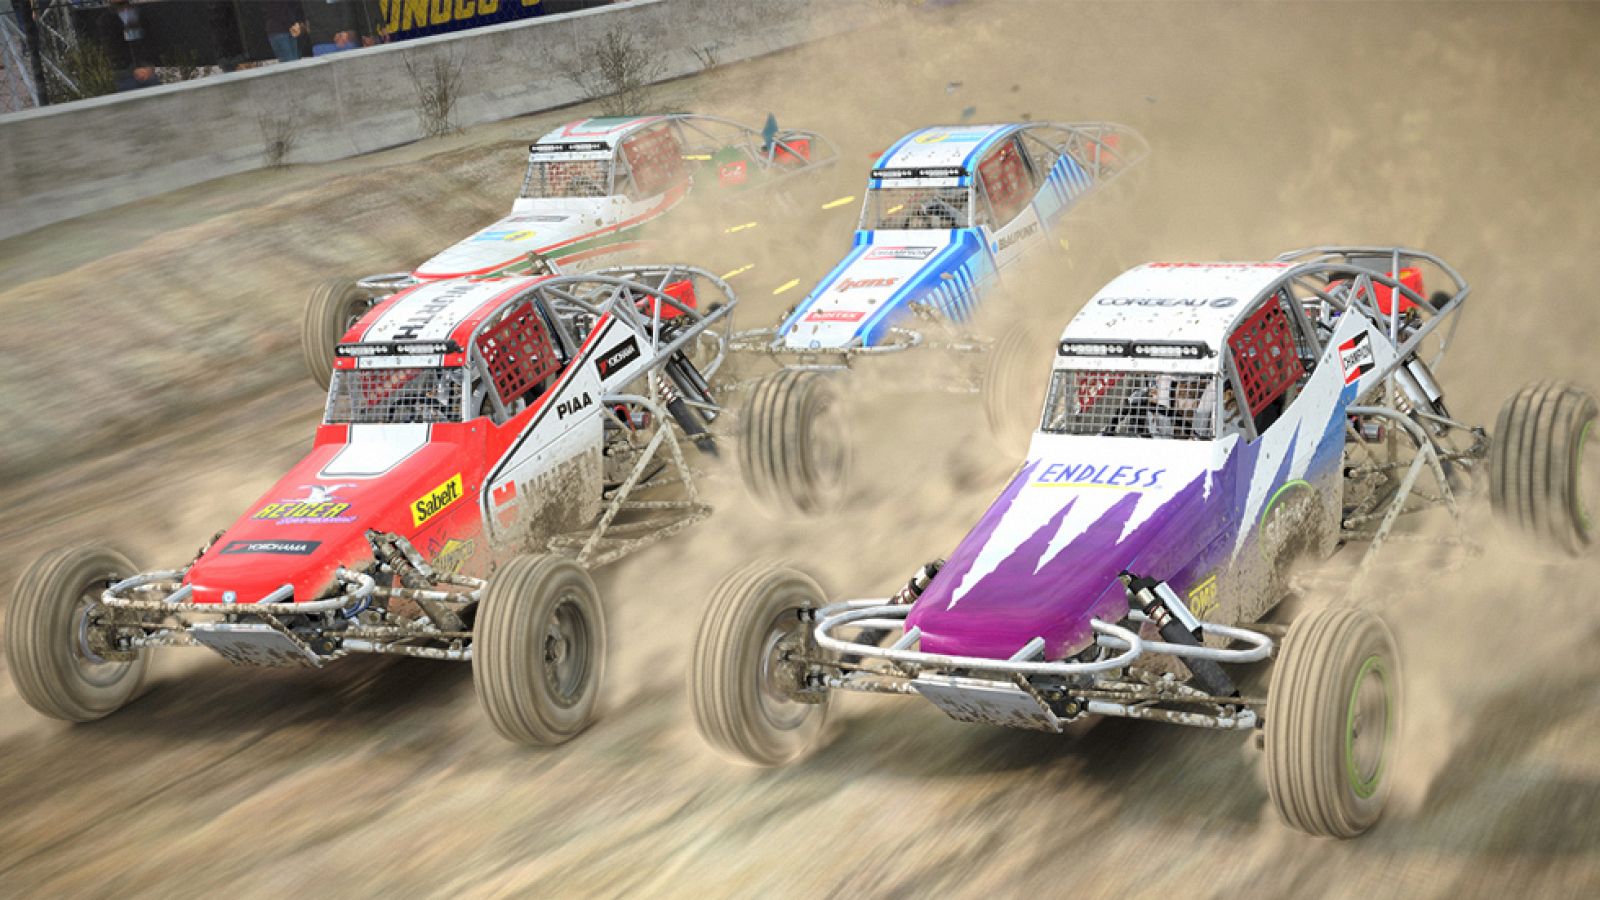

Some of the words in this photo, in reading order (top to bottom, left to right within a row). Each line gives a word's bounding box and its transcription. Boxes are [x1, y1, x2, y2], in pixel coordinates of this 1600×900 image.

[377, 0, 499, 35] UNOCO
[556, 391, 594, 420] PIAA
[1036, 463, 1167, 488] ENDLESS
[252, 502, 352, 520] REIGER
[415, 480, 459, 522] Sabelt
